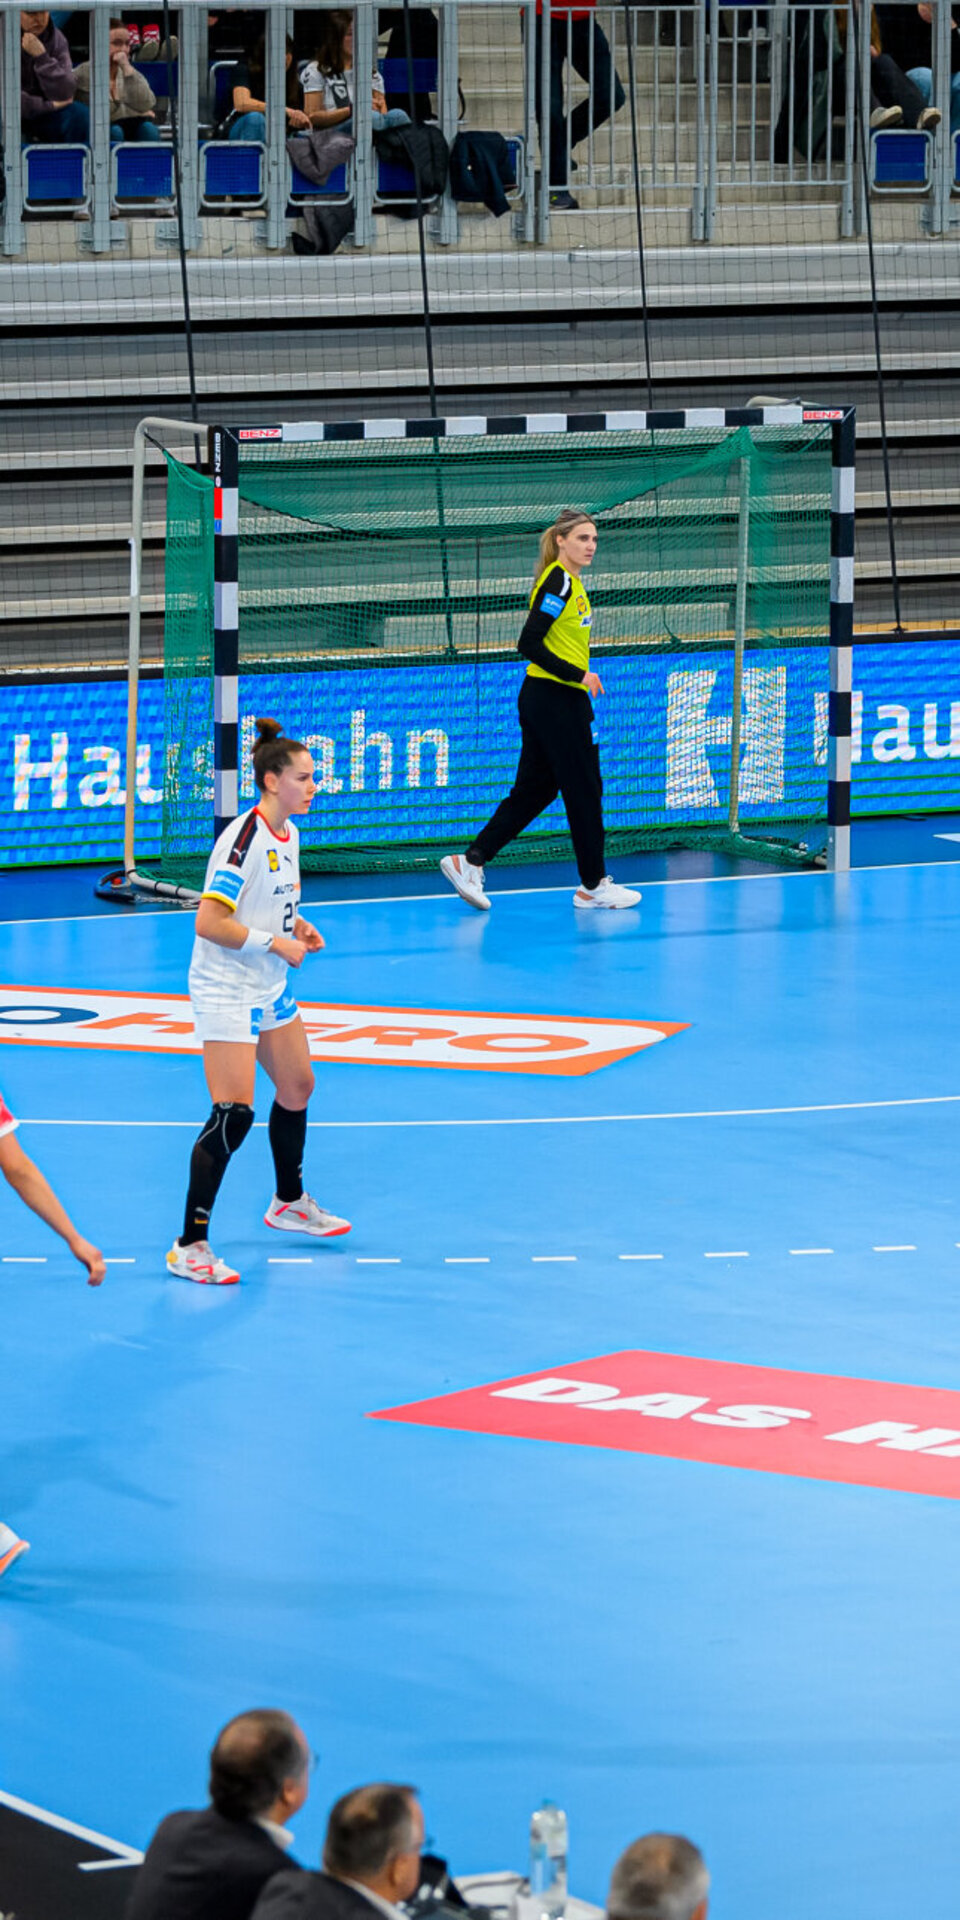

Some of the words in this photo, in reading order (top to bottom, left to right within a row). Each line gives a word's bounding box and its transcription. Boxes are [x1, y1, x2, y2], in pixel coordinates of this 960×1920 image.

[803, 411, 840, 419] BENZ
[240, 430, 280, 438] BENZ
[490, 1377, 811, 1428] DAS
